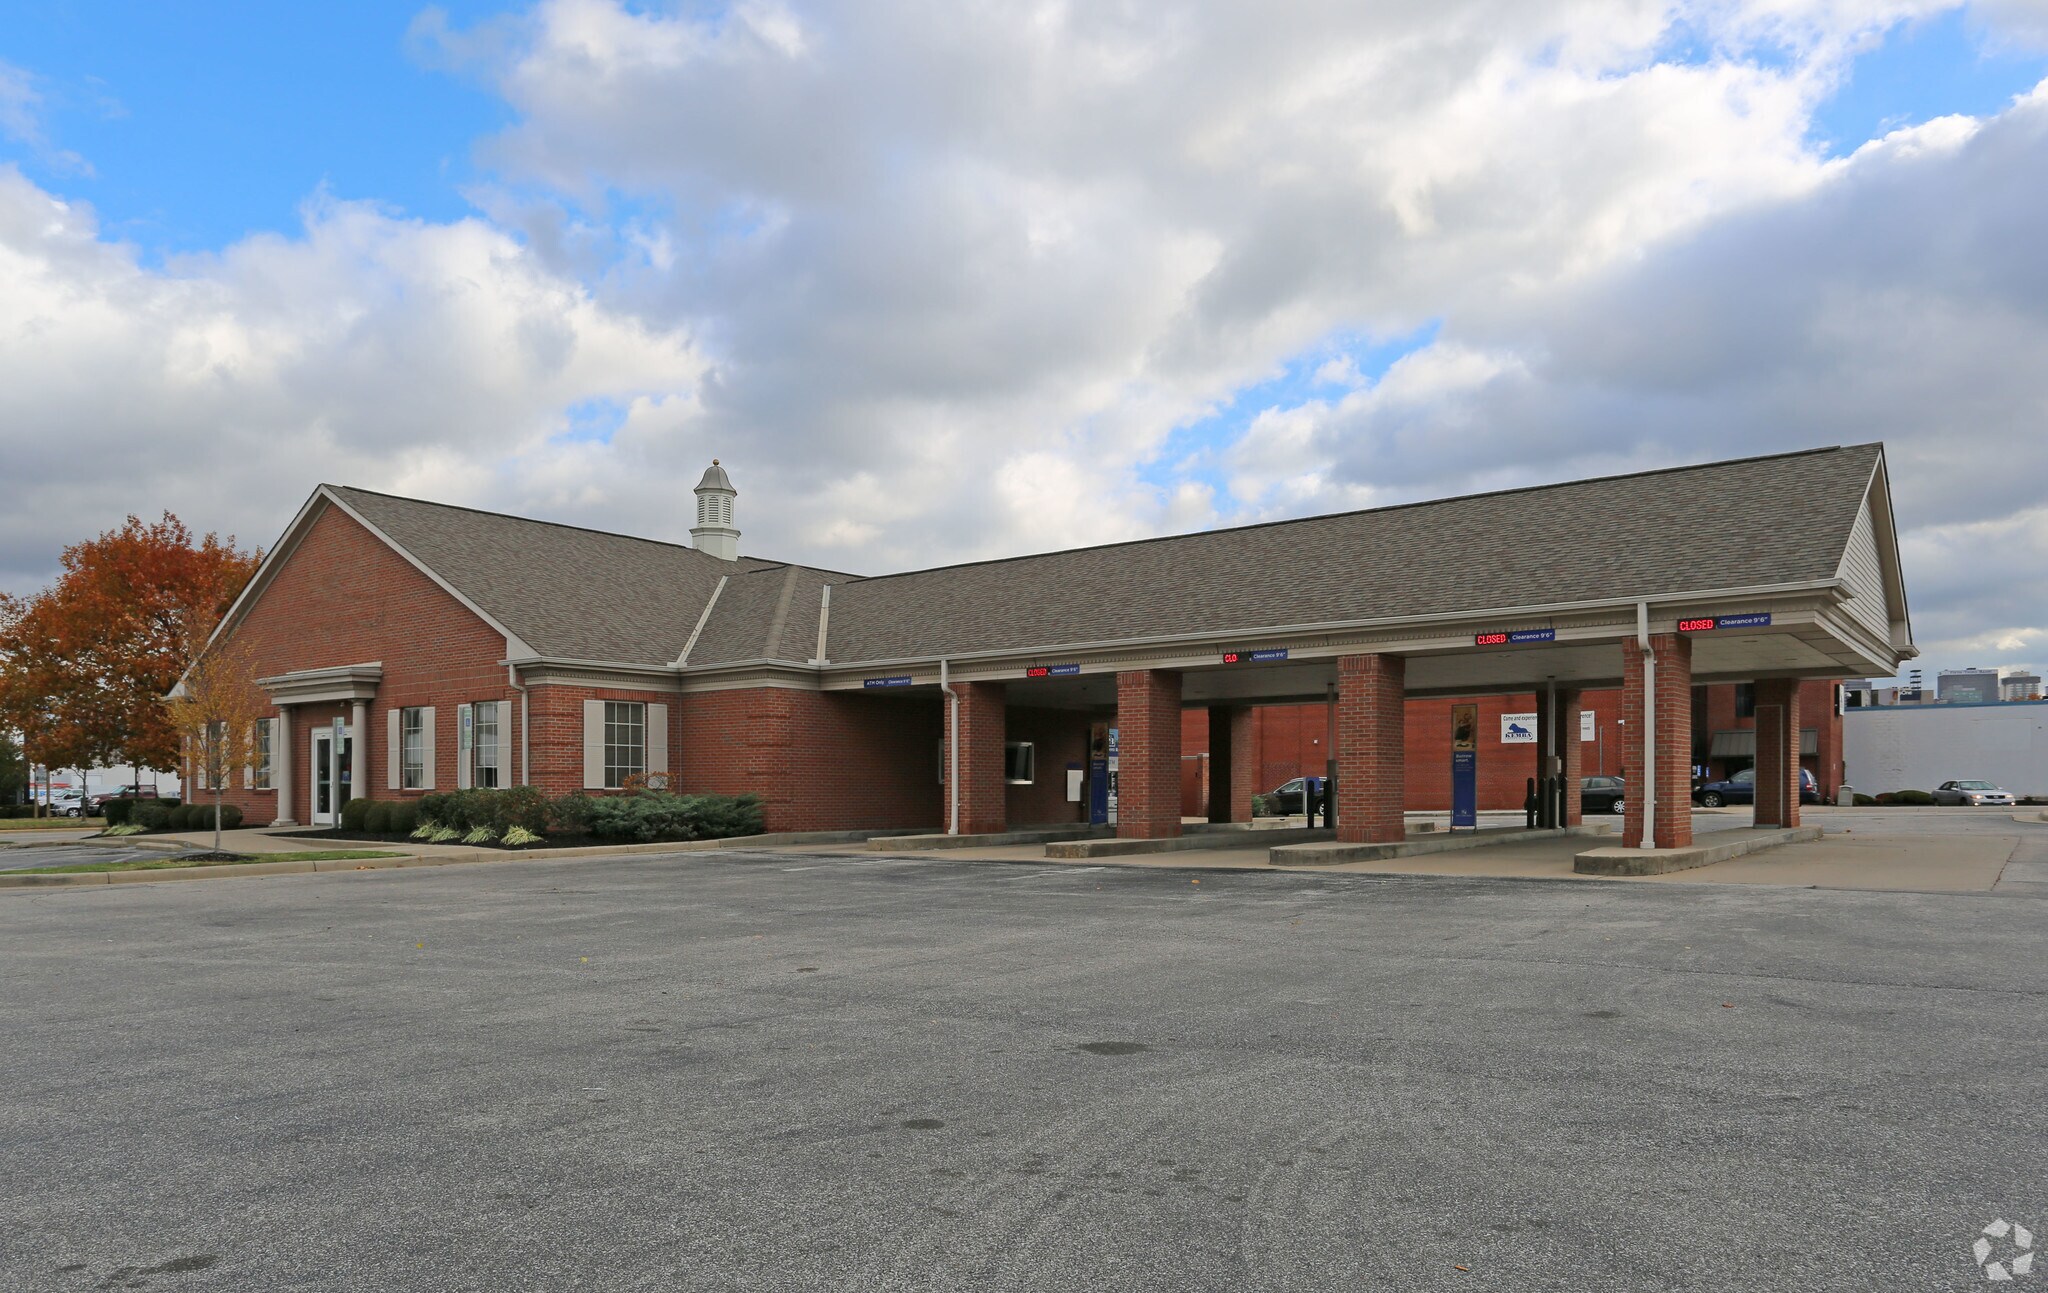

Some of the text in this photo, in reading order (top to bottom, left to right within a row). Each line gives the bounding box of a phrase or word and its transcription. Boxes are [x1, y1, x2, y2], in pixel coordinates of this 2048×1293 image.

[1679, 619, 1714, 631] CLOSED
[1720, 617, 1753, 625] Clearance
[1477, 634, 1506, 645] CLOSED
